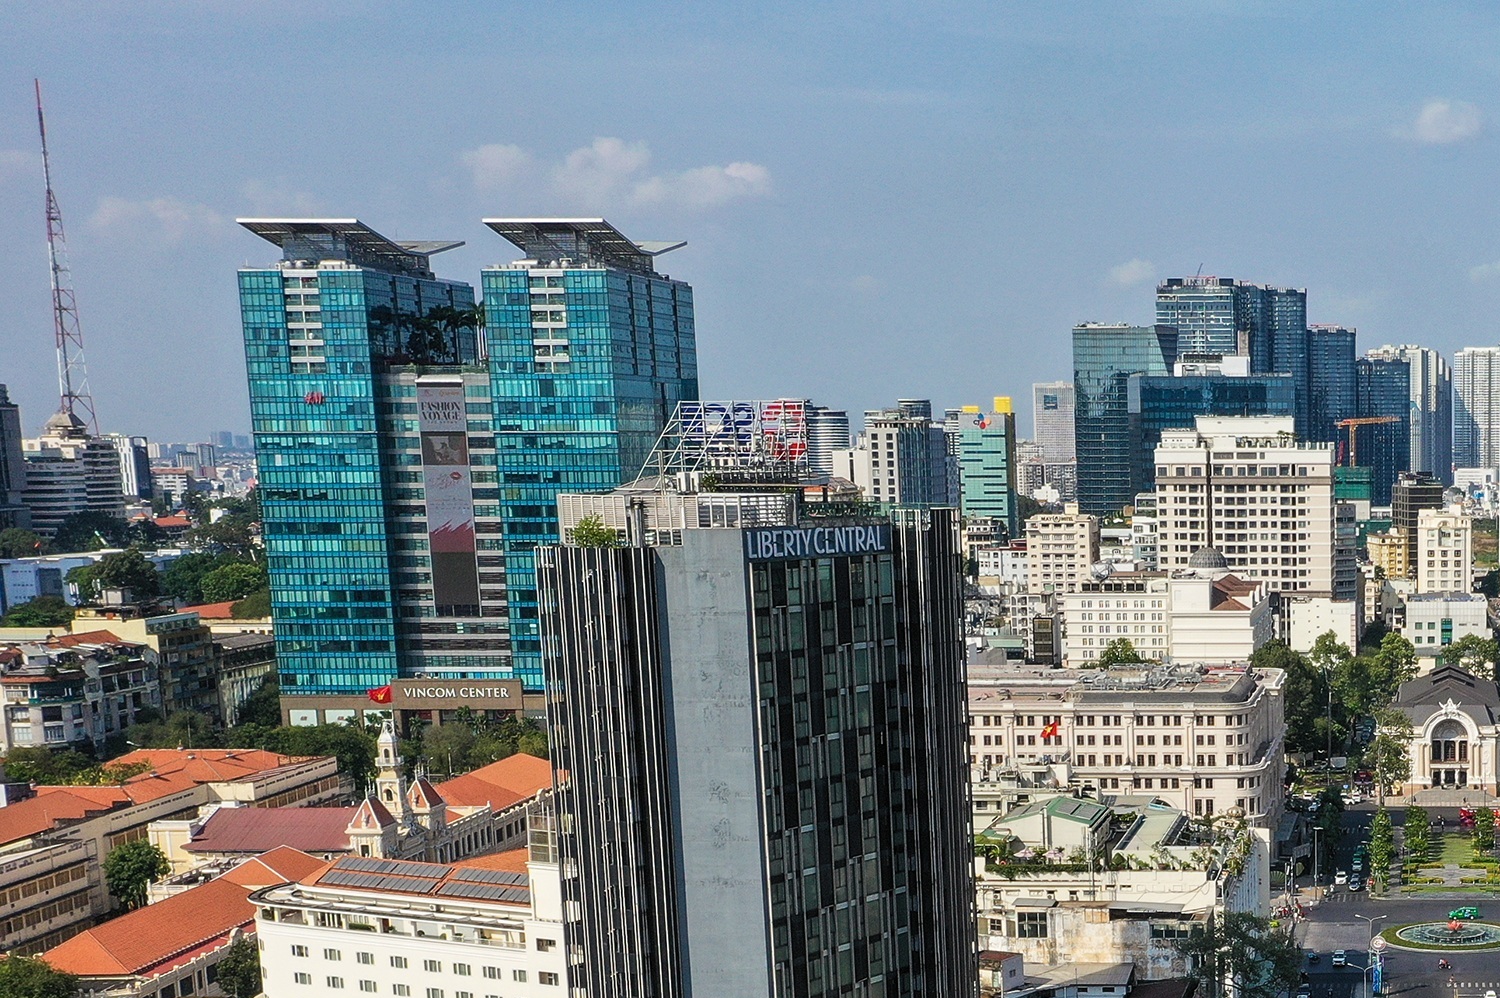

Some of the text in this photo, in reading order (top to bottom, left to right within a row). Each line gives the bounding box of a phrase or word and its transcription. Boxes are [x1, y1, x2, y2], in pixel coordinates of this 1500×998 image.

[421, 401, 460, 411] FASHION
[422, 411, 461, 421] VOYAGE
[746, 525, 886, 559] LIBERTY CENTRAL
[403, 687, 509, 698] VINCOM CENTER
